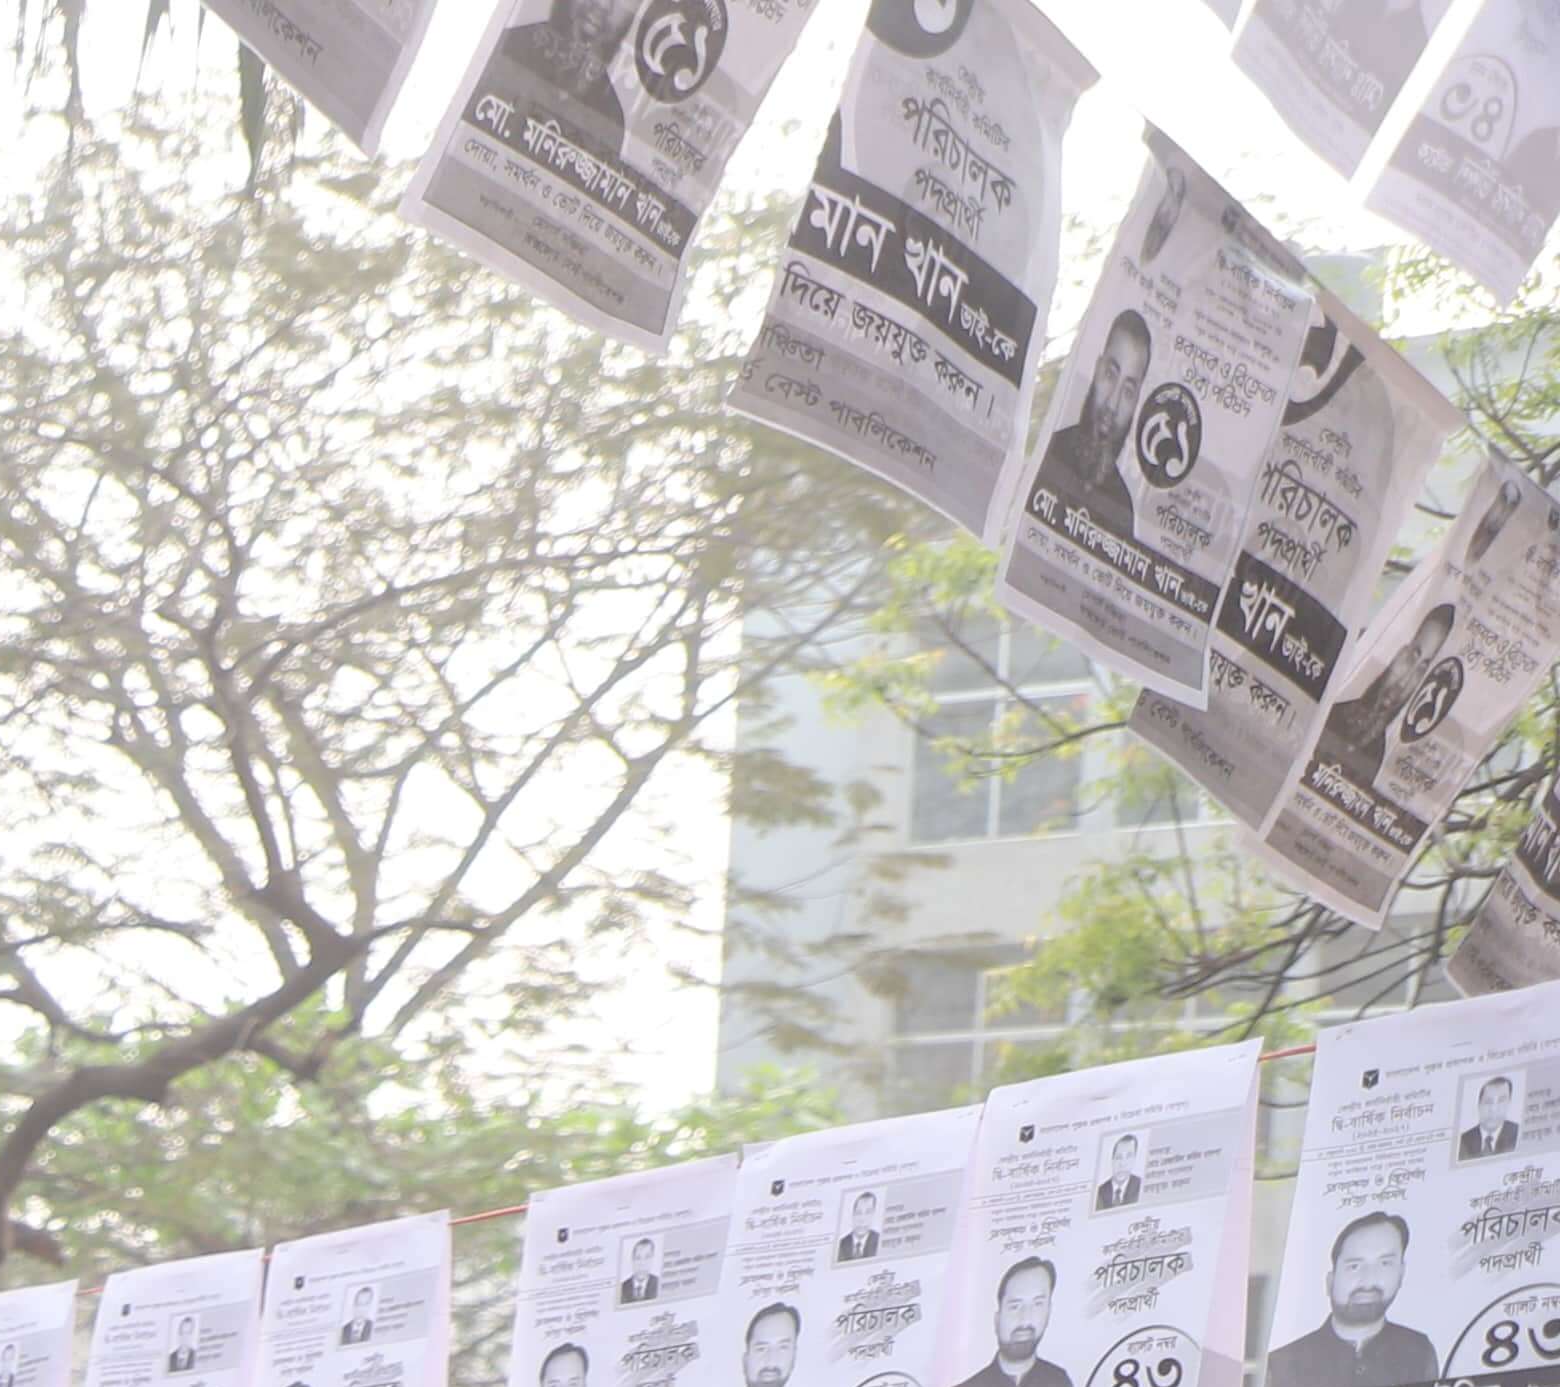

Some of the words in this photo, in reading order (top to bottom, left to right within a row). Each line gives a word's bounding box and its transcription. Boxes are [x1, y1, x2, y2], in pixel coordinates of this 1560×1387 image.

[475, 95, 514, 137] মো.
[636, 192, 666, 231] খান
[901, 96, 1016, 216] পরিচালক
[915, 168, 986, 241] পদপ্রার্থী
[780, 261, 845, 319] দিয়ে
[852, 301, 930, 365] জয়যুক্ত
[904, 236, 970, 323] খান
[765, 370, 823, 407] বেস্ট
[829, 399, 937, 471] পাবলিকেশন
[1154, 562, 1184, 602] খান
[1240, 579, 1295, 653] খান
[1095, 1251, 1188, 1289] পরিচালক
[1479, 1241, 1544, 1273] পদপ্রার্থী
[835, 1300, 922, 1338] পরিচালক
[1481, 1318, 1560, 1367] ৪৩
